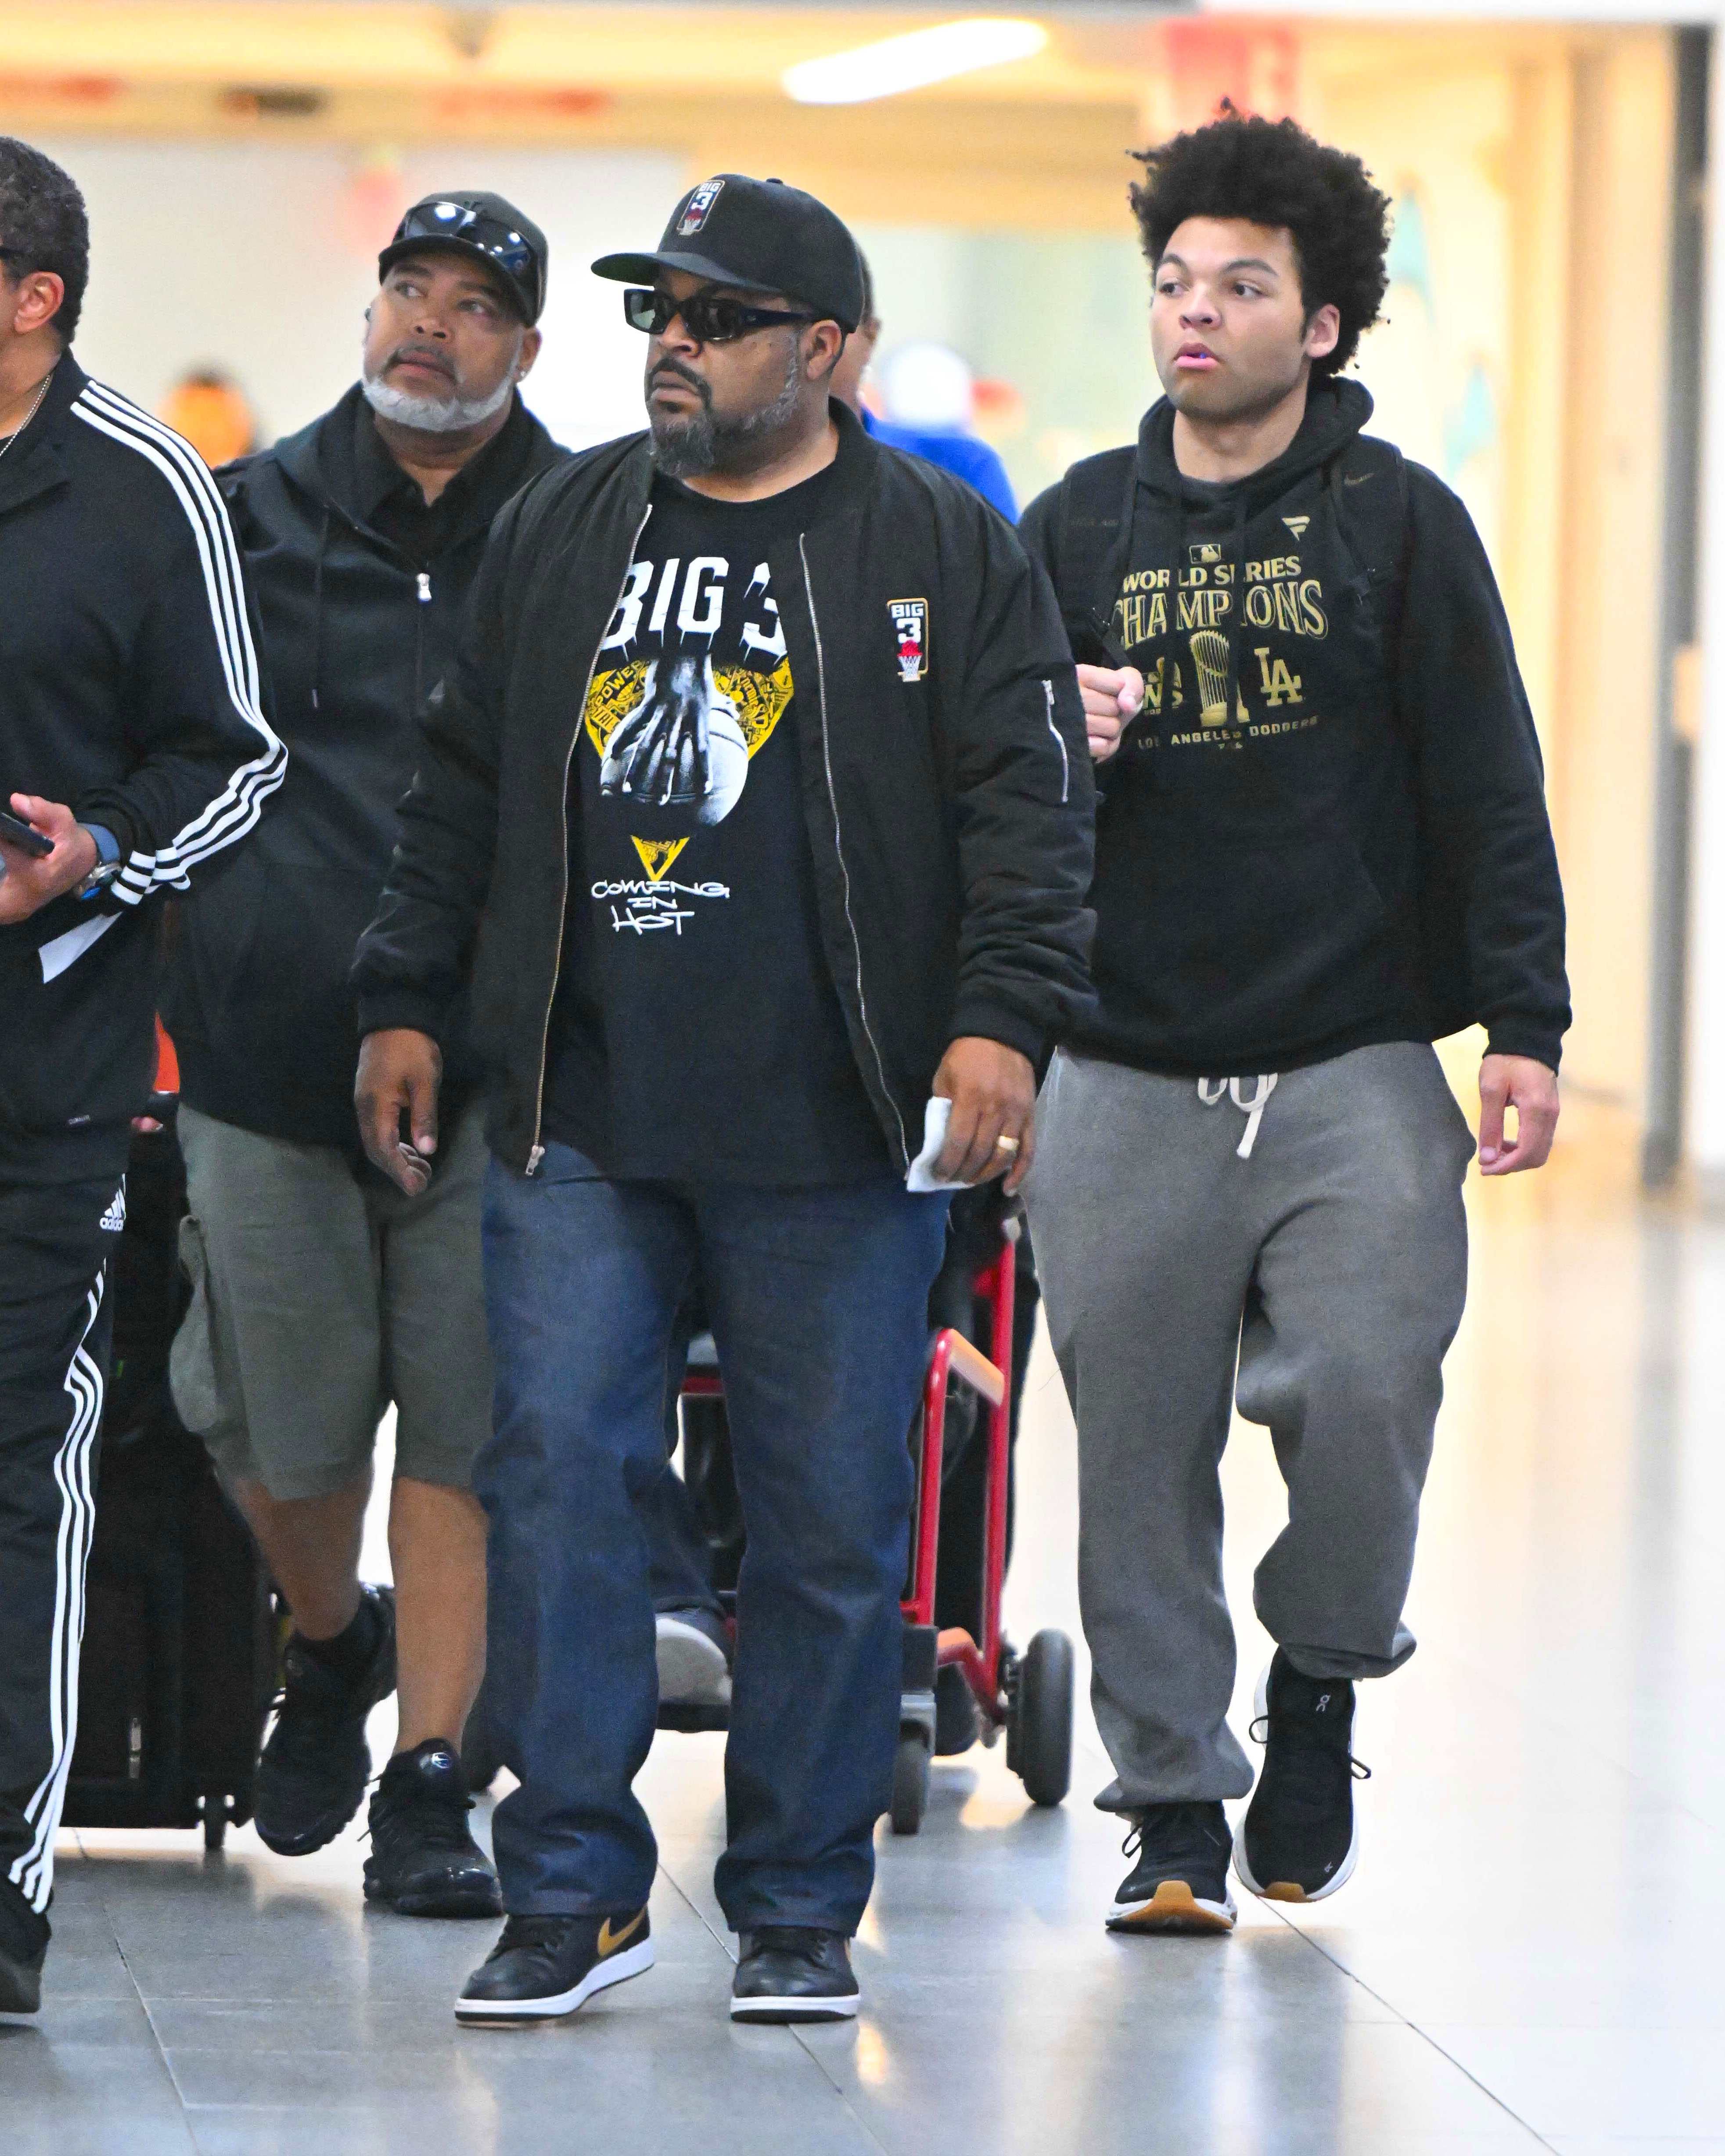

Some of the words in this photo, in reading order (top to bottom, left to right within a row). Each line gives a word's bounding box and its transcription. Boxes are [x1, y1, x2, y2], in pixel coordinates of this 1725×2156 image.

[691, 191, 713, 210] 3
[698, 183, 721, 192] BIG
[1214, 556, 1301, 585] SRIES
[600, 557, 729, 658] BIG
[891, 604, 924, 618] BIG
[1112, 580, 1328, 650] HAMPONS
[896, 618, 921, 643] 3
[595, 660, 645, 707] POWER
[1254, 647, 1303, 707] LA
[627, 896, 677, 909] IN
[611, 905, 695, 935] HOT
